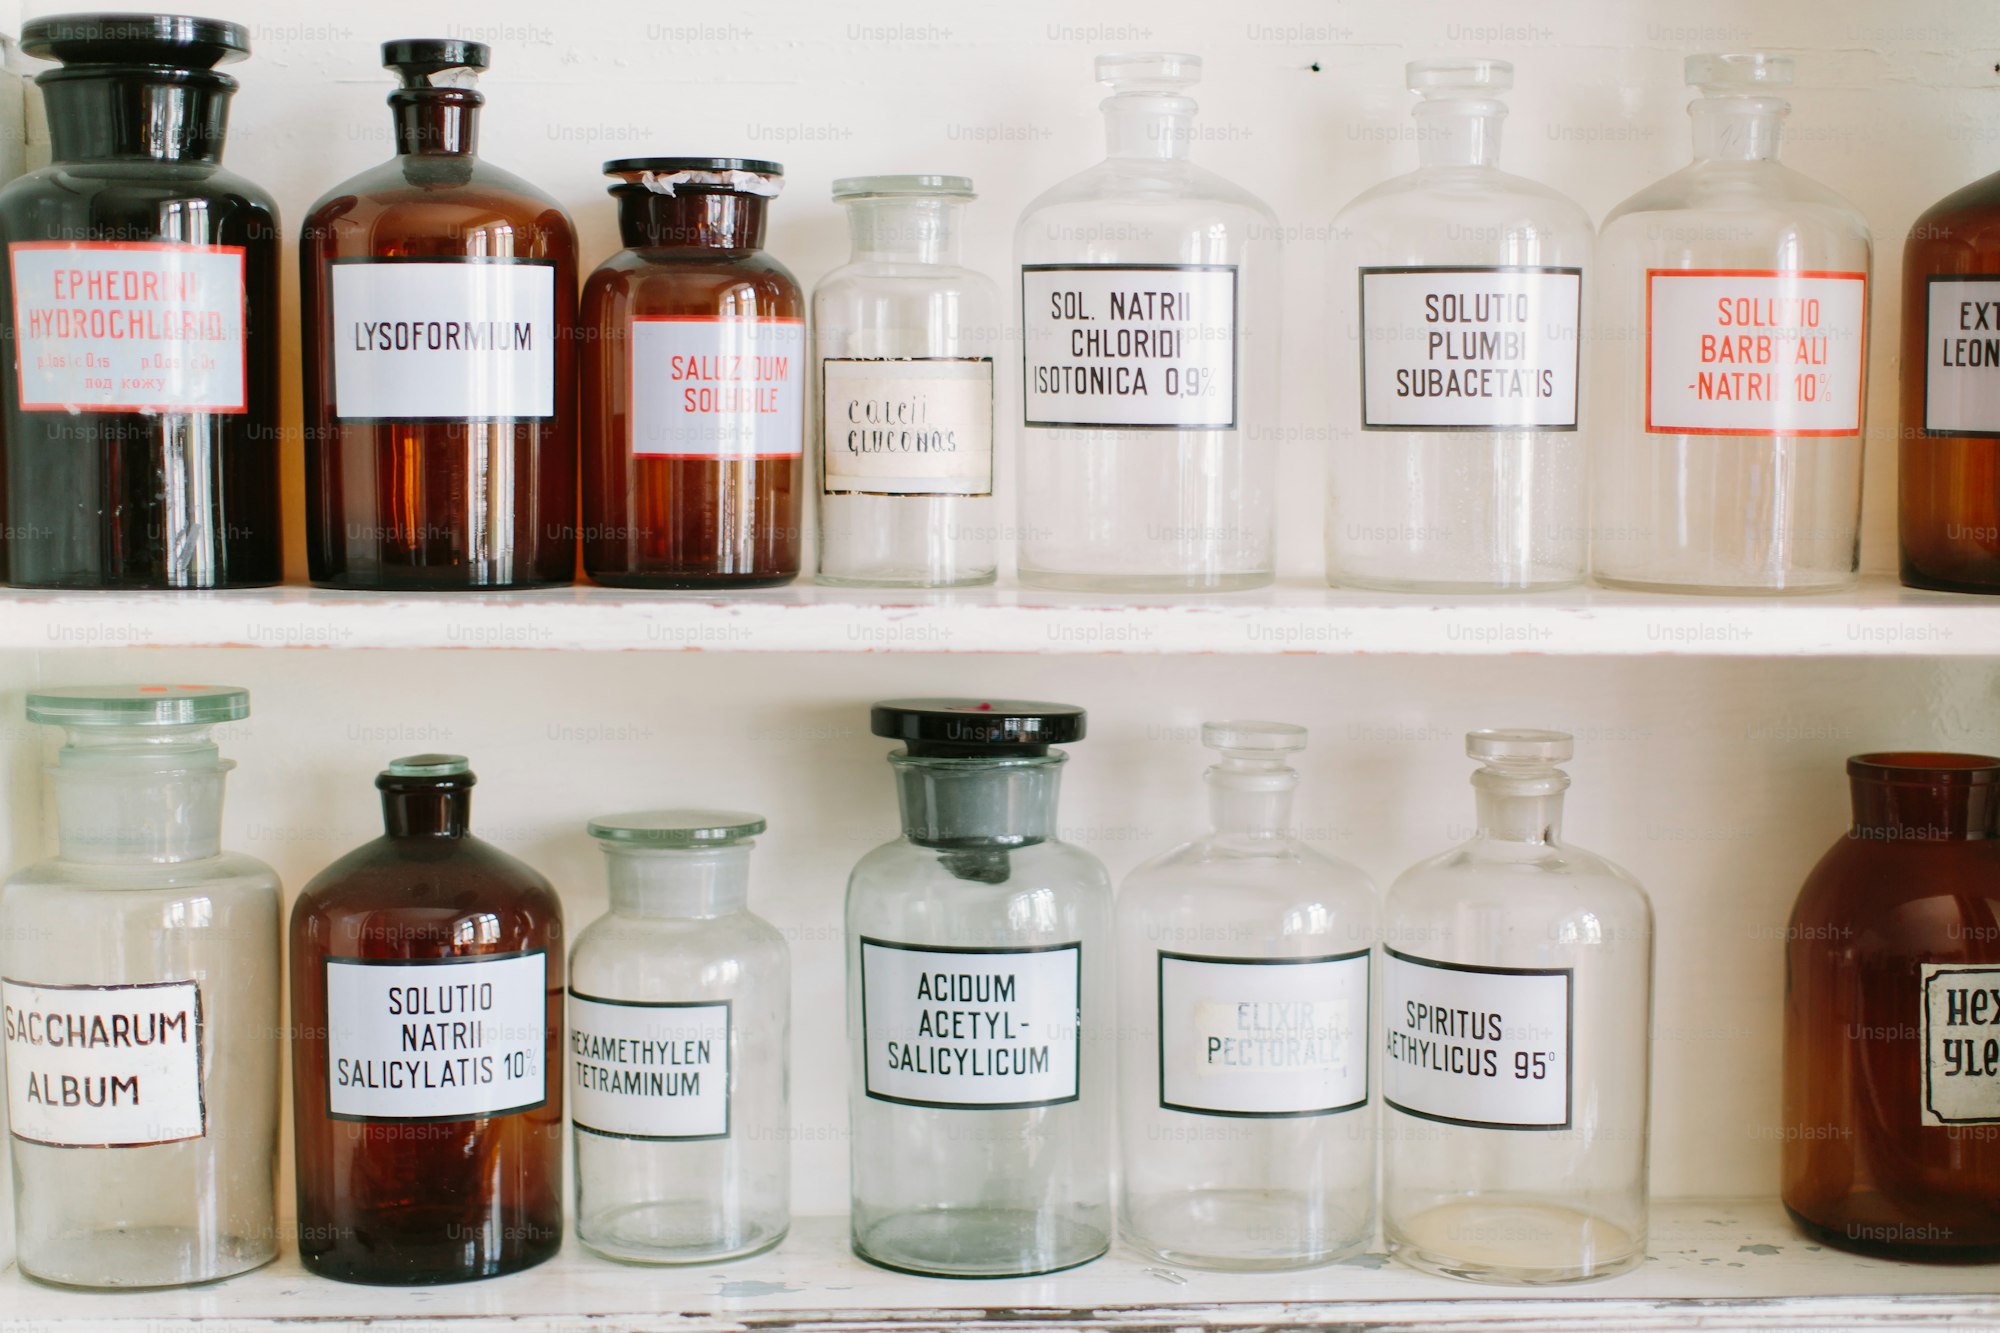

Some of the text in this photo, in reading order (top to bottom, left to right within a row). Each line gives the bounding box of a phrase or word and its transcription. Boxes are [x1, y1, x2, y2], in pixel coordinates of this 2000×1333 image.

[54, 269, 196, 301] EPHEDRINI
[1051, 291, 1190, 321] SOL. NATRII
[1425, 293, 1528, 323] SOLUTIO
[355, 322, 532, 351] LYSOFORMIUM
[1071, 329, 1182, 358] CHLORIDI
[1428, 331, 1526, 360] PLUMBI
[671, 355, 788, 381] SALUZDUM
[1943, 338, 2000, 367] LEON
[1034, 366, 1148, 395] ISOTONICA
[1396, 368, 1554, 398] SUBACETATIS
[1793, 373, 1834, 402] 10%
[684, 387, 779, 413] SOLUBILE
[388, 982, 493, 1016] SOLUTIO
[917, 972, 1016, 1003] ACIDUM
[5, 1005, 187, 1048] SACCHARUM
[918, 1009, 1030, 1040] ACETYL-
[1236, 1001, 1314, 1031] ELIXIR
[1406, 1000, 1502, 1042] SPIRITUS
[402, 1020, 482, 1052] NATRII
[570, 1029, 711, 1066] HEXAMETHYLEN
[888, 1041, 1049, 1076] SALICYLICUM
[1386, 1027, 1498, 1078] AETHYLICUS
[338, 1048, 538, 1089] SALICYLATIS 10%
[576, 1060, 700, 1097] TETRAMINUM
[27, 1070, 140, 1108] ALBUM
